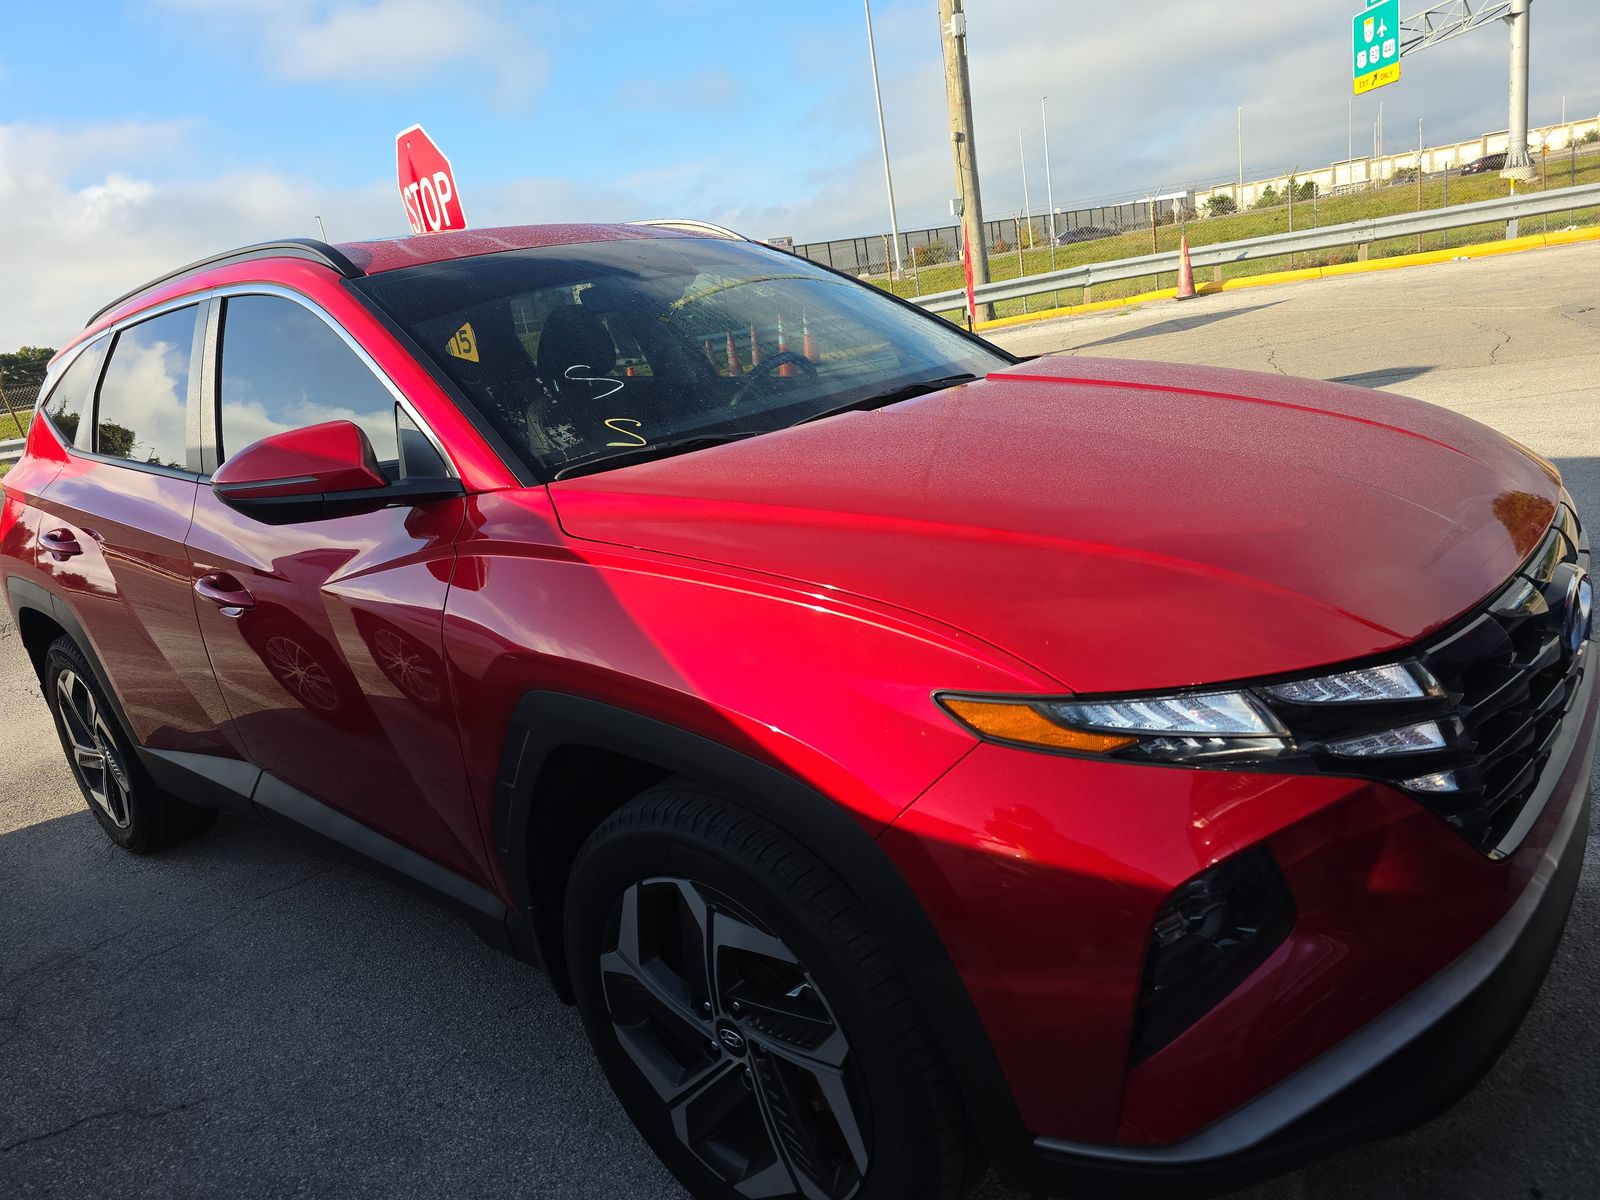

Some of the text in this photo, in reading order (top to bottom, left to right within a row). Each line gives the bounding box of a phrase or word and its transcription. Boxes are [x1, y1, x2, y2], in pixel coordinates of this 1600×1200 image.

[1359, 70, 1393, 89] EXIT ONLY
[403, 171, 453, 233] STOP
[453, 330, 472, 355] 15
